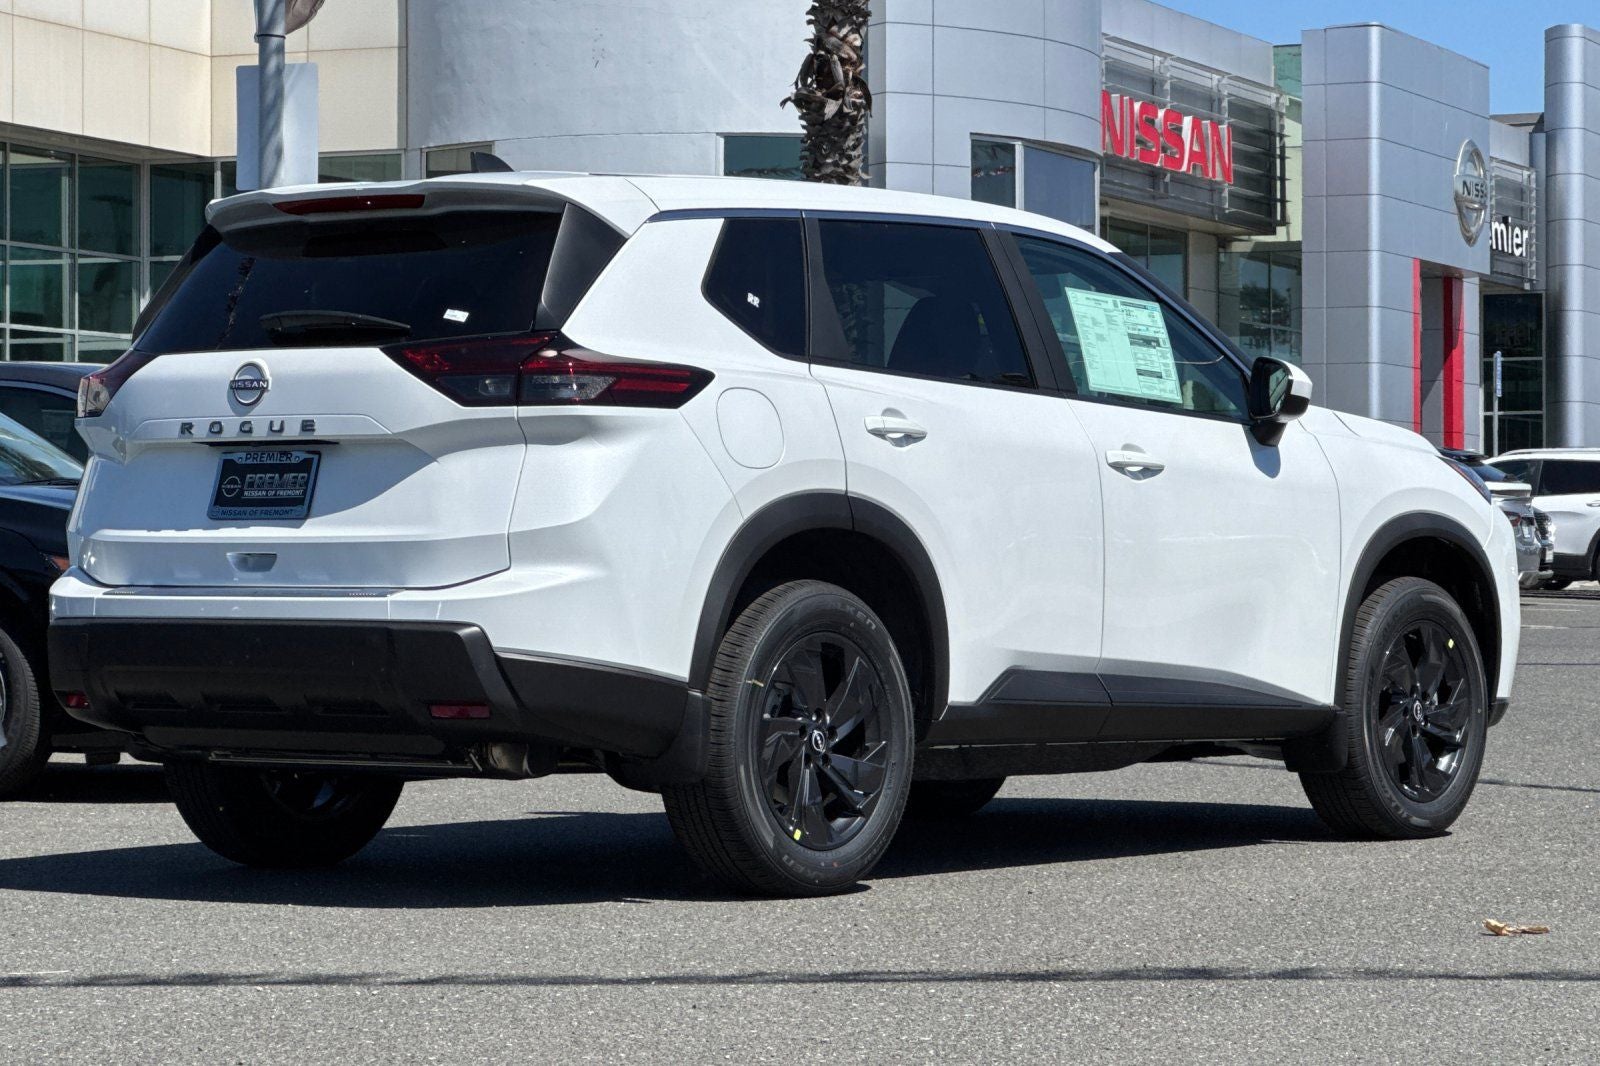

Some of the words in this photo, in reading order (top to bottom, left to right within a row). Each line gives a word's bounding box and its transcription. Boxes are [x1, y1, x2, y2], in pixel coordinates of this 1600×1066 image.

[1101, 89, 1234, 184] NISSAN
[1462, 180, 1488, 198] NISS
[1489, 216, 1529, 257] mier
[232, 380, 268, 388] NISSAN
[180, 419, 316, 435] ROGUE
[244, 452, 293, 462] PREMIER
[243, 473, 308, 489] PREMIER
[267, 489, 277, 497] OF
[276, 489, 304, 497] FREMONT
[220, 509, 247, 517] NISSAN
[249, 509, 259, 517] OF
[260, 508, 294, 517] FREMONT
